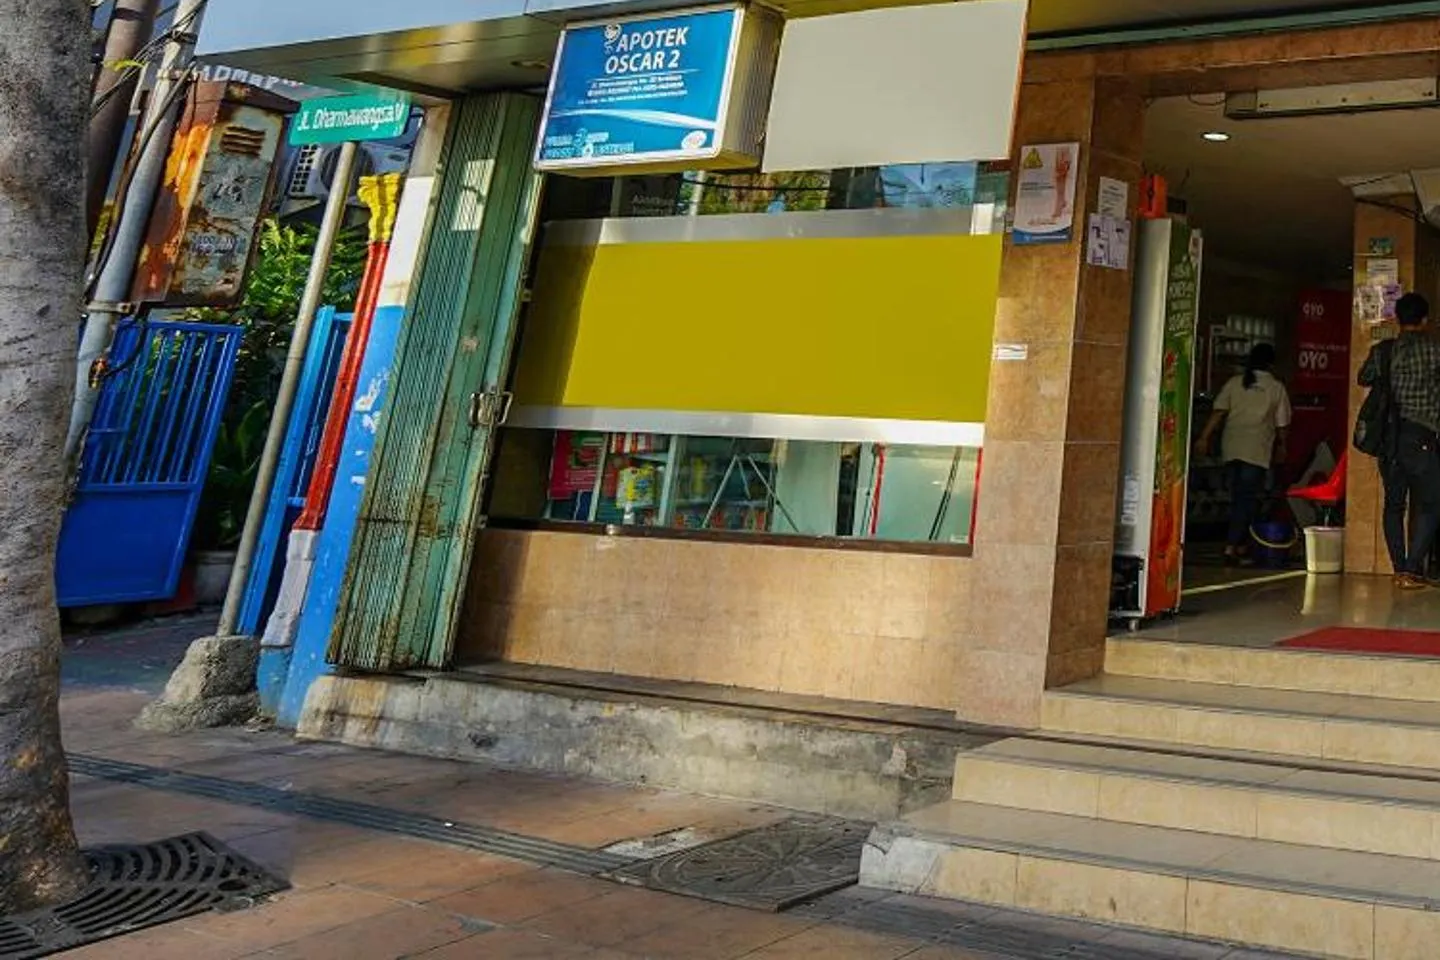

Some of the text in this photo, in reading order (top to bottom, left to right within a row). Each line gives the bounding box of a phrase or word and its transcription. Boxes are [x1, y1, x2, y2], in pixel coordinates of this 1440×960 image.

[616, 26, 689, 52] APOTEK
[605, 49, 680, 74] OSCAR 2
[1299, 350, 1328, 370] OYO
